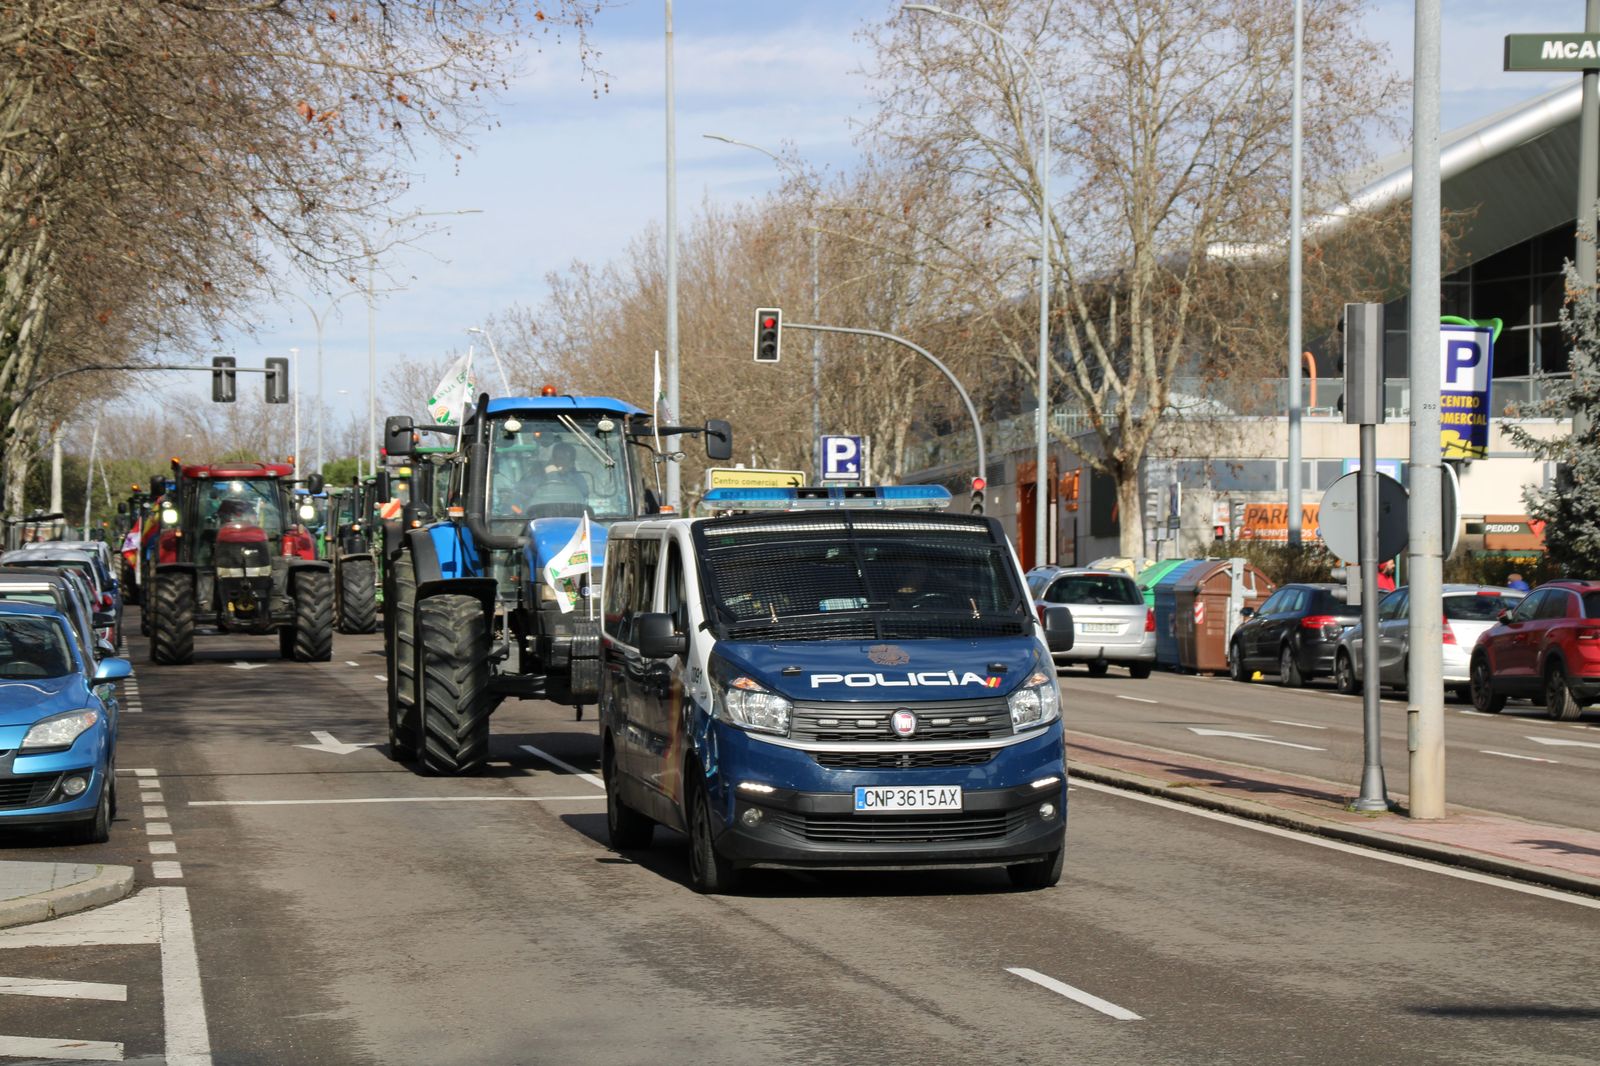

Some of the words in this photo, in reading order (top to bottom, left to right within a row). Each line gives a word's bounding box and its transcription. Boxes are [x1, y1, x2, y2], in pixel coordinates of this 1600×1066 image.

[1541, 40, 1600, 60] McA
[1446, 339, 1482, 383] P
[1440, 394, 1480, 409] CENTRO
[1440, 412, 1488, 426] OMERCIAL
[827, 438, 857, 473] P
[713, 477, 739, 485] Centro
[741, 478, 778, 487] comercial
[1485, 524, 1521, 533] PEDIDO
[811, 670, 988, 688] POLICÍA
